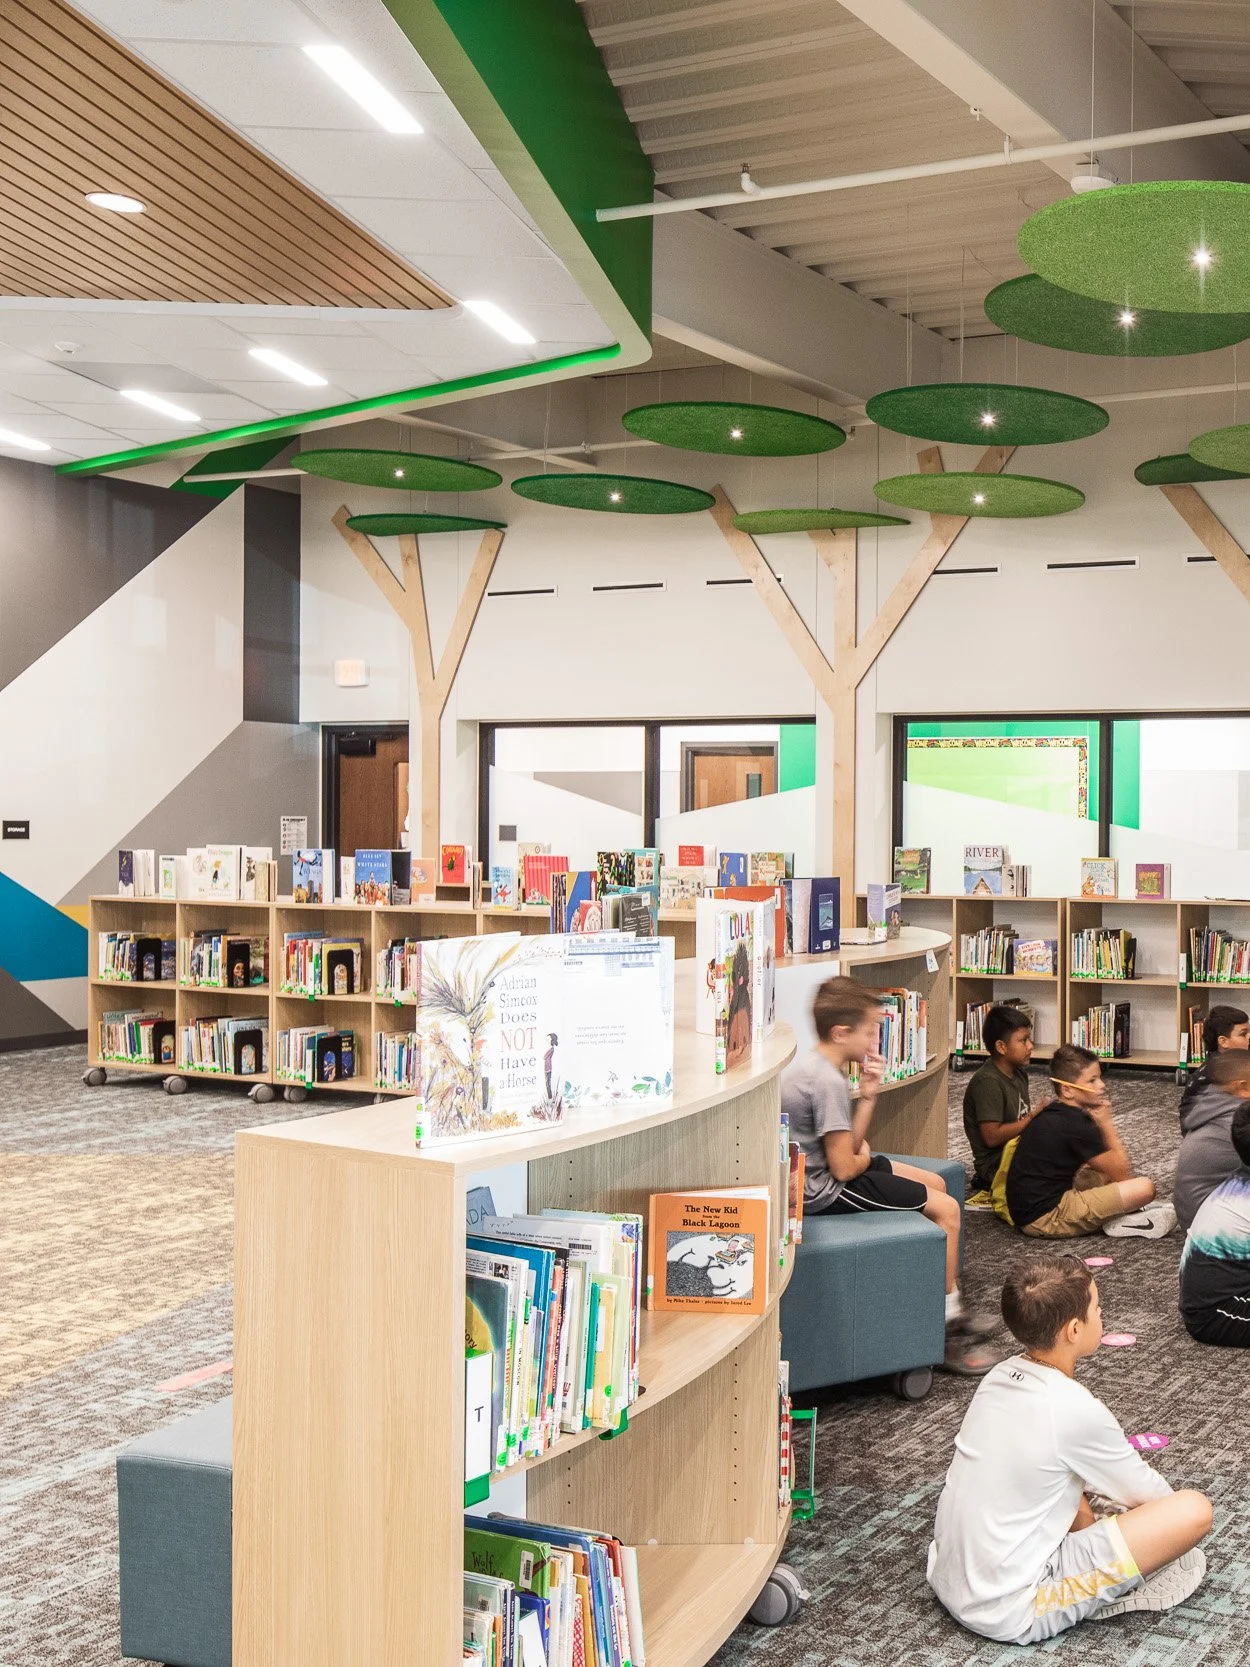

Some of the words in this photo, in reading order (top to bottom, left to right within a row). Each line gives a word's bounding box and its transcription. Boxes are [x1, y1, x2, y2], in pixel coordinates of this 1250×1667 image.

[965, 847, 999, 858] RIVER
[500, 975, 537, 991] Adrian
[499, 994, 537, 1008] Simcox
[500, 1012, 537, 1024] Does
[500, 1027, 537, 1052] NOT
[500, 1056, 537, 1070] Have
[499, 1081, 505, 1089] a
[507, 1073, 537, 1088] Horse
[685, 1205, 700, 1213] The
[682, 1219, 706, 1227] Black
[709, 1220, 740, 1229] Lagoon
[474, 1407, 485, 1422] T
[472, 1551, 494, 1571] Wolf
